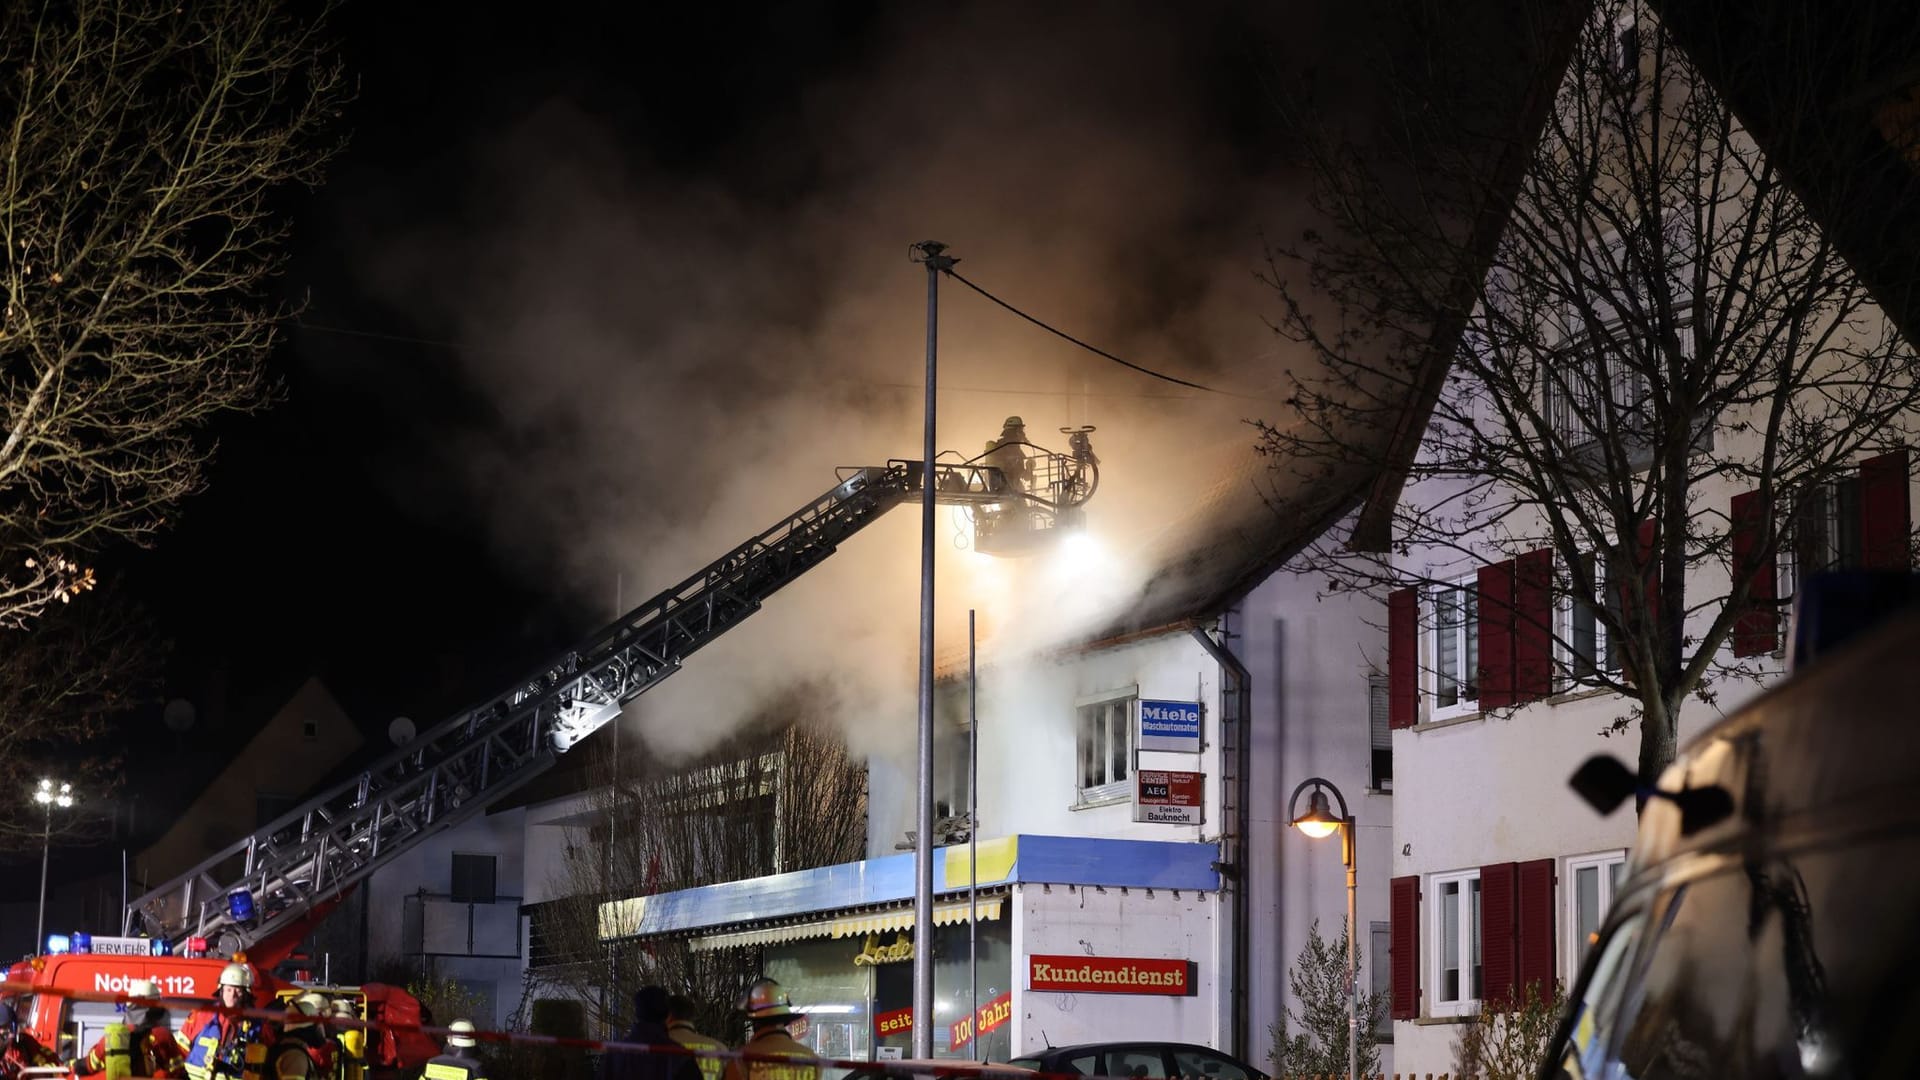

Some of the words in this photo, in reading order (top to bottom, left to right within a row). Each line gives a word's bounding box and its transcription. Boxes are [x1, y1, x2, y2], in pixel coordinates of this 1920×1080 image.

[1143, 707, 1198, 721] Miele
[1143, 721, 1198, 732] Waschautomaten
[1146, 787, 1167, 796] AEG
[1148, 812, 1190, 822] Bauknecht
[91, 943, 146, 956] UERWEHR
[1033, 964, 1183, 985] Kundendienst
[165, 976, 195, 994] 112
[880, 1013, 913, 1032] seit
[979, 1001, 1010, 1031] Jahr
